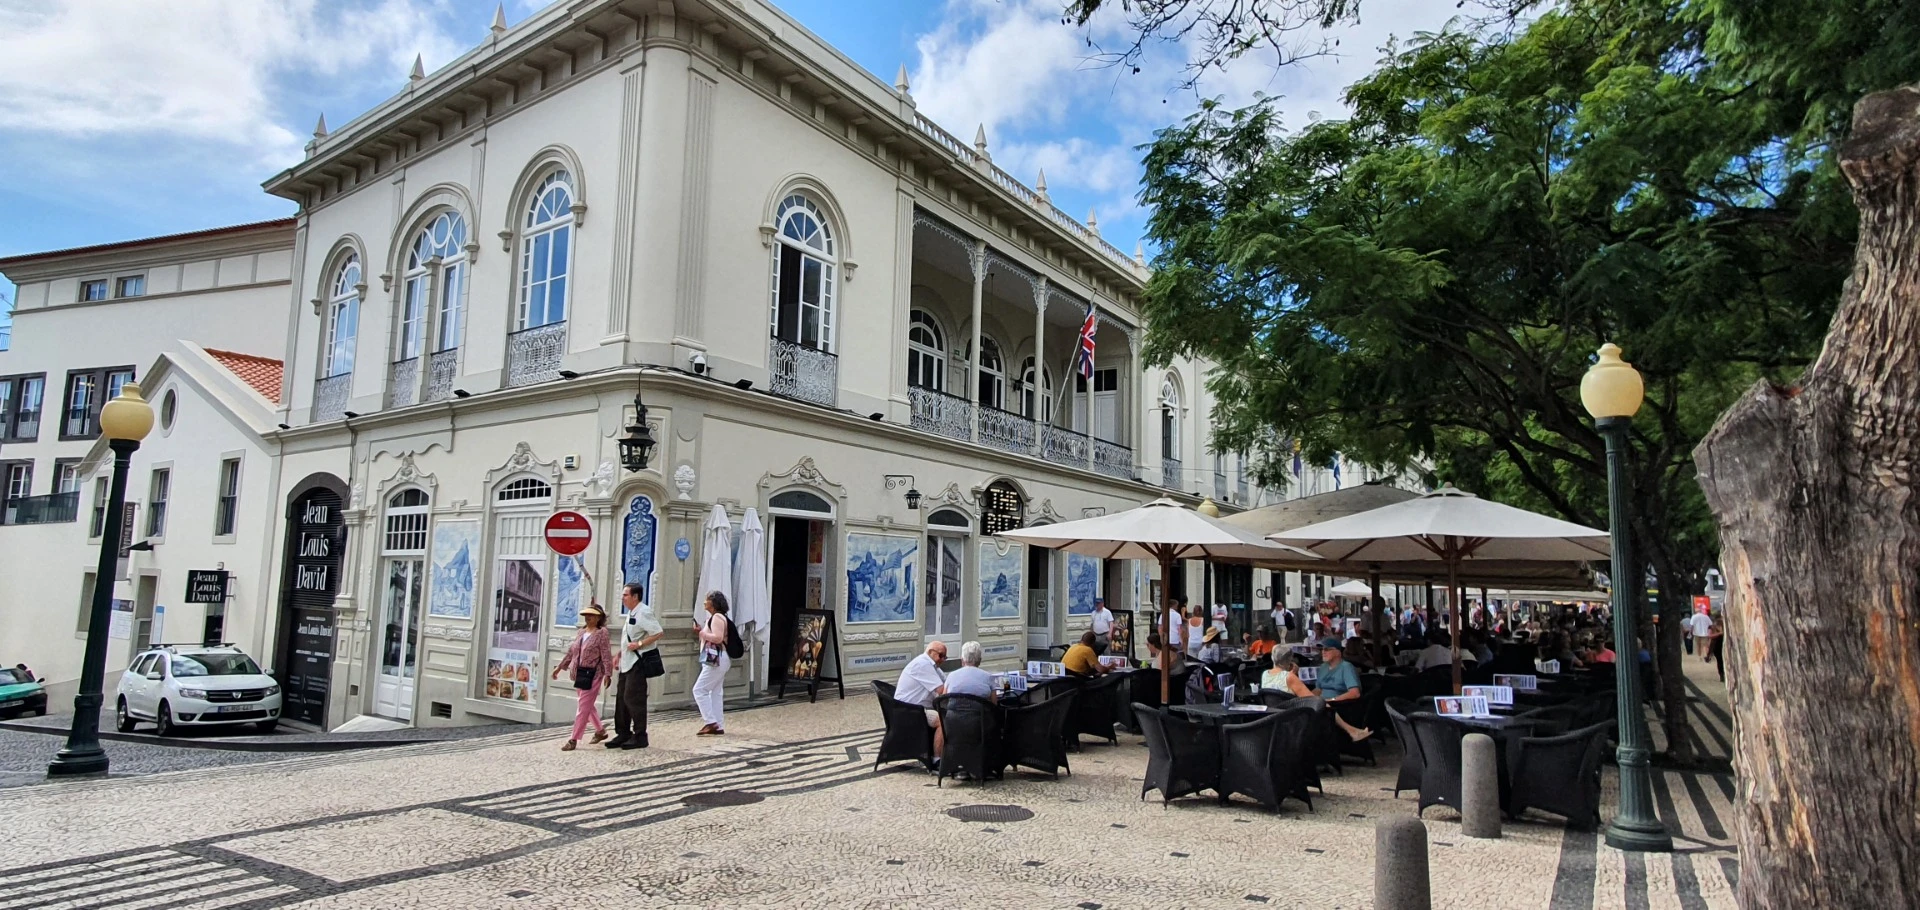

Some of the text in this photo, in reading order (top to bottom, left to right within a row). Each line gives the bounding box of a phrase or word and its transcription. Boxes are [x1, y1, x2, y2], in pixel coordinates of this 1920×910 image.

[990, 488, 1017, 511] THE
[303, 500, 328, 524] Jean
[987, 513, 1021, 533] RITZ
[300, 532, 329, 556] Louis
[193, 572, 218, 582] Jean
[193, 582, 221, 592] Louis
[296, 565, 328, 590] David
[192, 592, 221, 602] David
